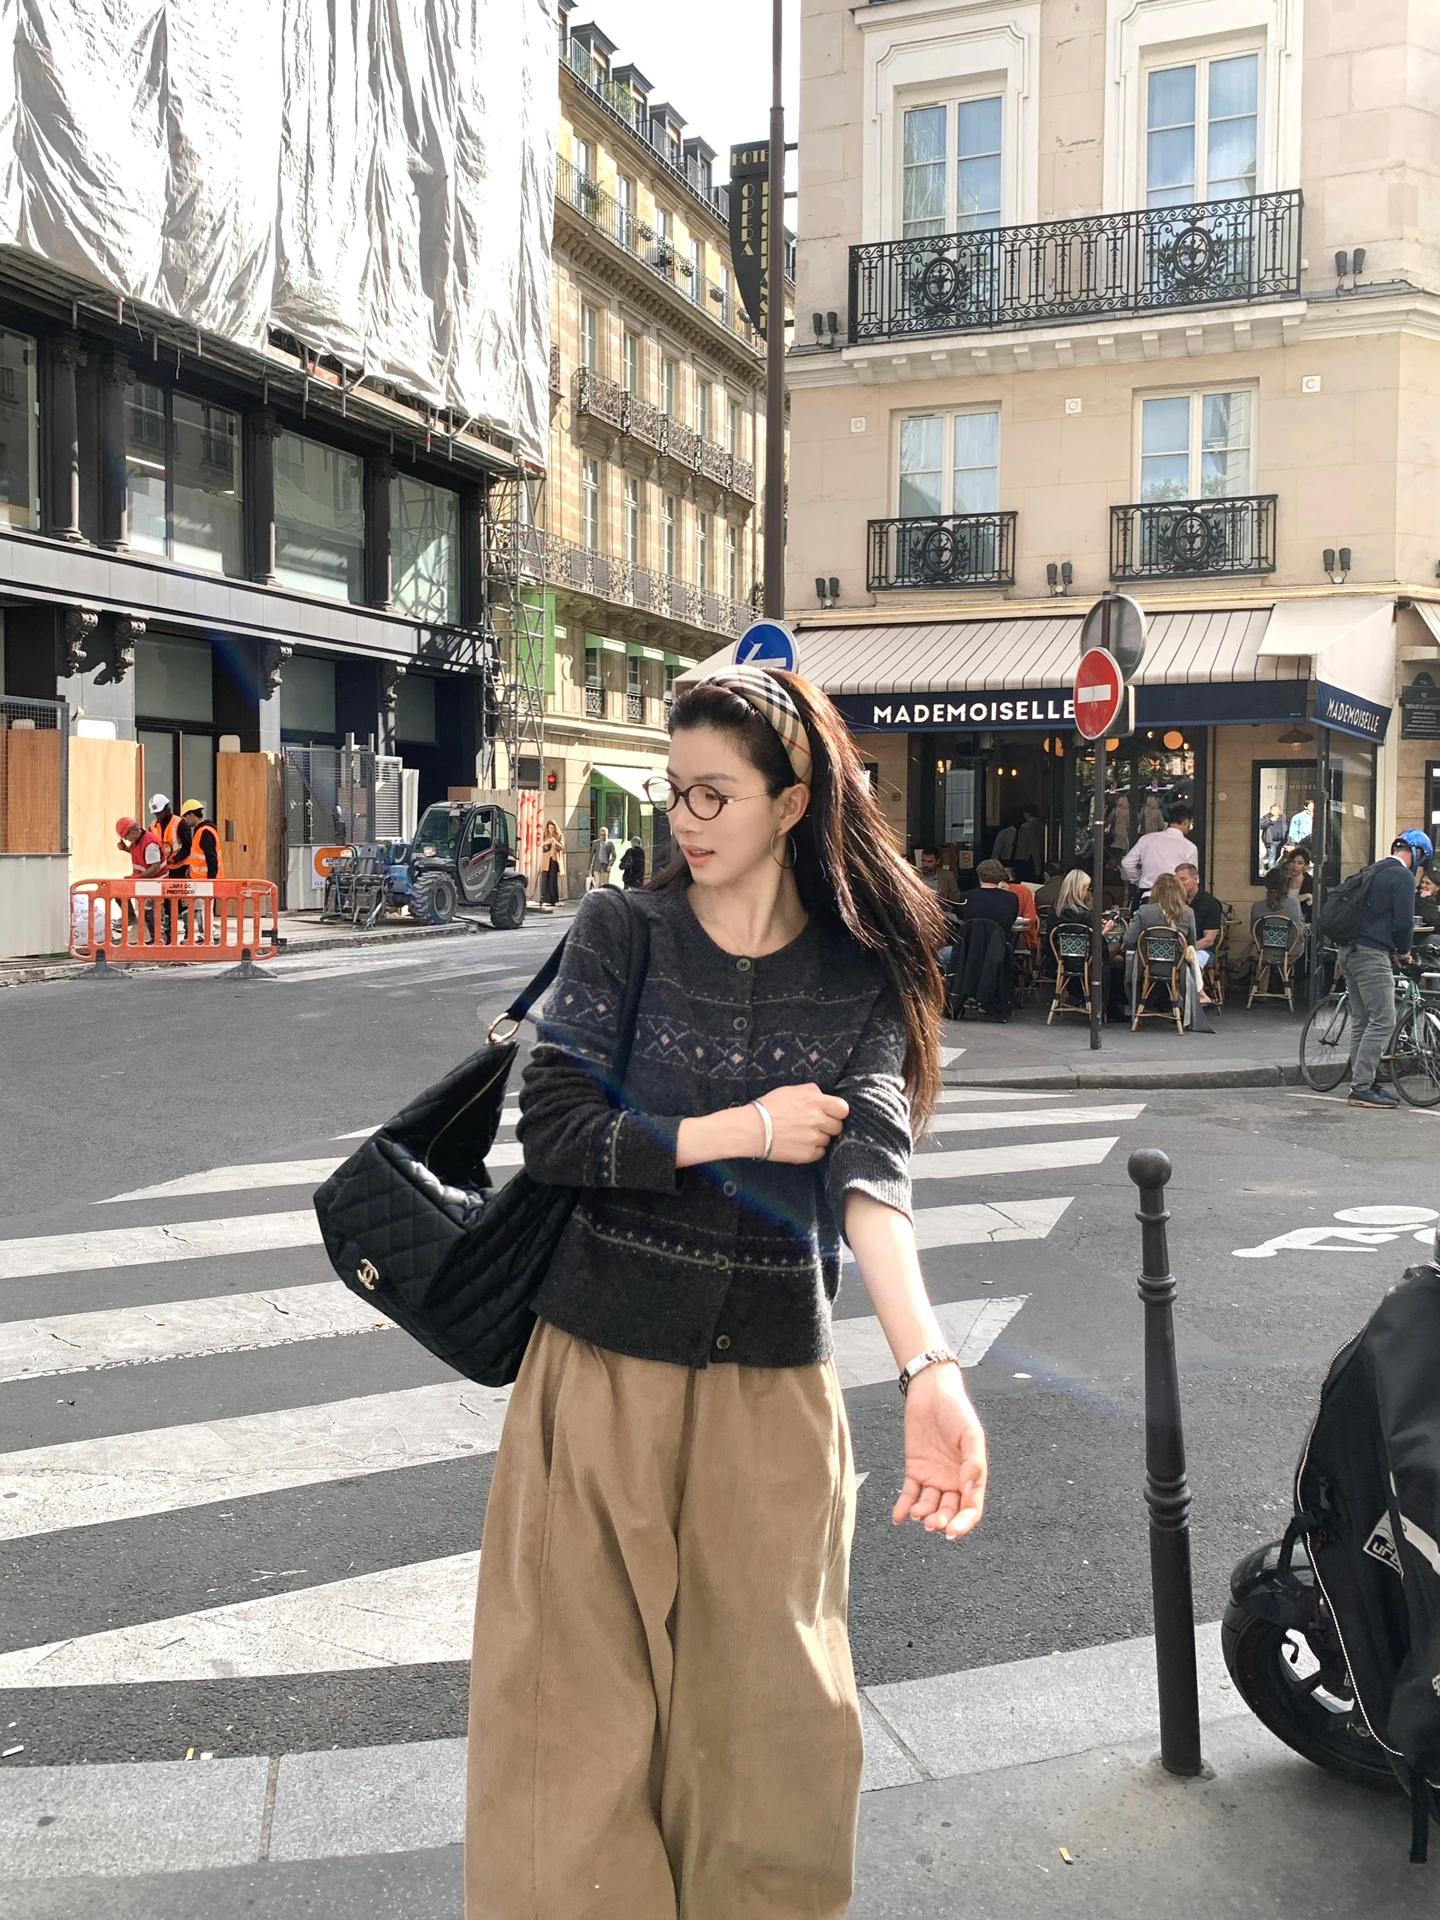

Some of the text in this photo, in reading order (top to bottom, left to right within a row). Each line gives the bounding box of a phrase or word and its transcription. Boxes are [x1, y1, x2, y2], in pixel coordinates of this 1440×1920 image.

[731, 149, 769, 166] HOTE
[740, 183, 755, 257] OPERA
[873, 700, 1076, 723] MADEMOISELLE
[1326, 698, 1380, 733] MADEMOISELLE
